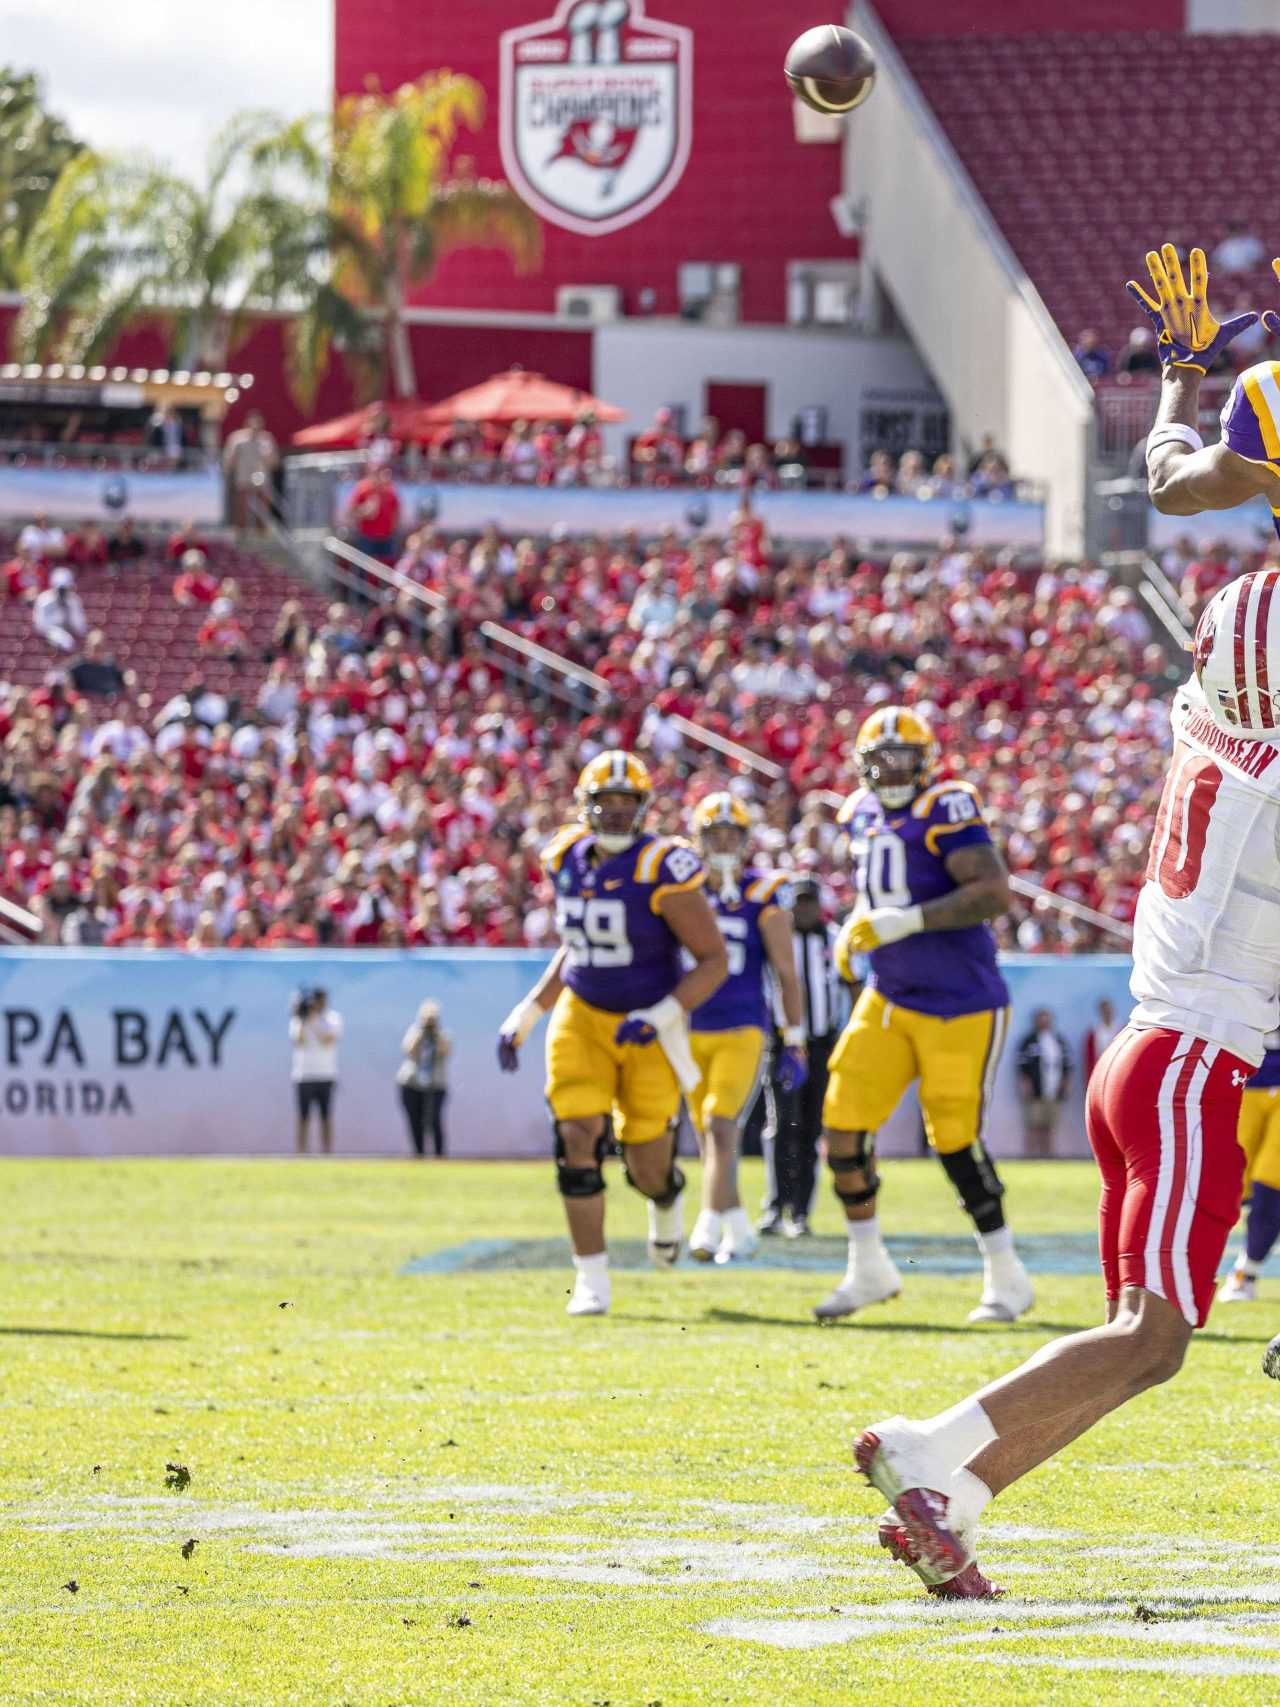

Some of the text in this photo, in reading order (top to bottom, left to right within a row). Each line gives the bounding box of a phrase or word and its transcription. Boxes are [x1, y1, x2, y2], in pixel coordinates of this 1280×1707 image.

[1146, 755, 1224, 900] 10
[113, 1008, 236, 1069] BAY
[0, 1082, 134, 1114] ORIDA
